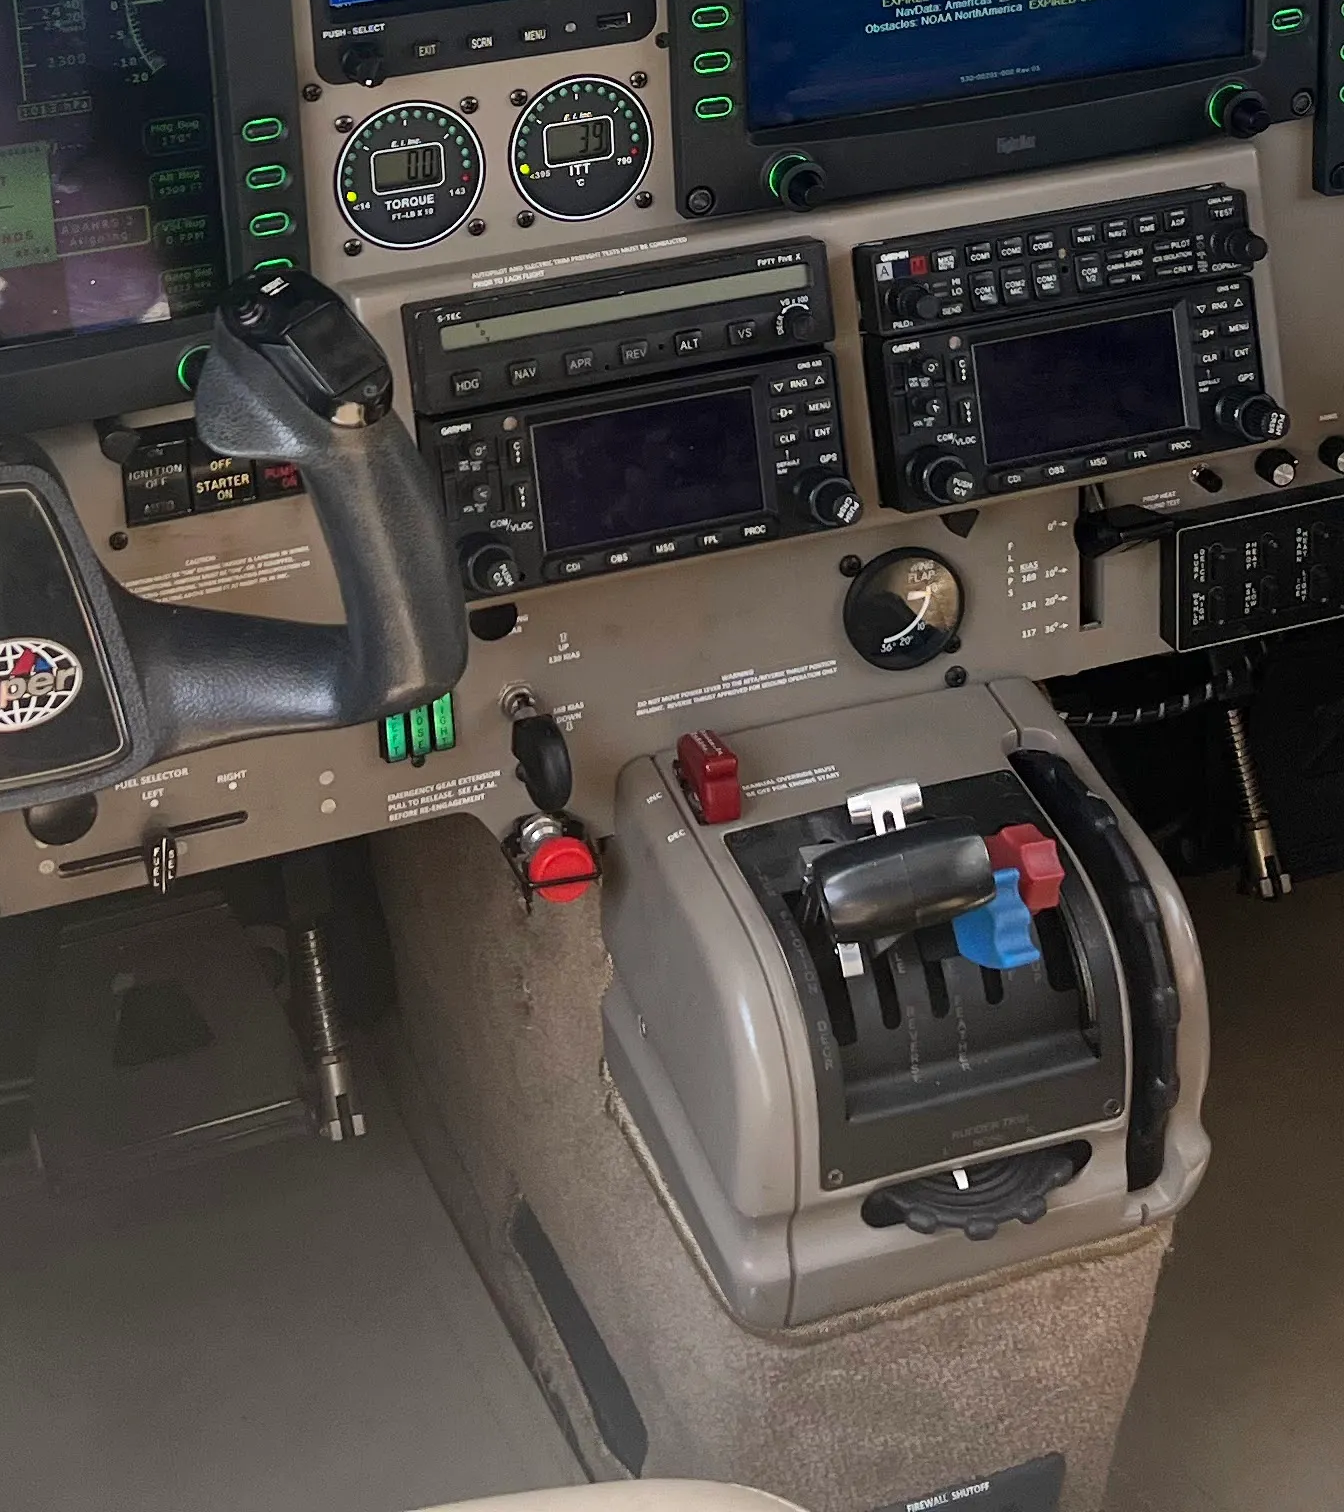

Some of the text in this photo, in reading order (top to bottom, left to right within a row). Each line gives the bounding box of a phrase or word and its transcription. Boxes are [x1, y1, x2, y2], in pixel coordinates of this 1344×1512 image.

[921, 13, 952, 26] NOAA
[955, 4, 1023, 21] NorthAmerica
[524, 29, 546, 42] MENU
[471, 37, 492, 49] SCRN
[418, 44, 436, 56] EXIT
[578, 123, 604, 154] 39
[569, 163, 591, 176] ITT
[385, 194, 435, 211] TORQUE
[437, 311, 462, 323] S-TEC
[737, 327, 752, 339] VS
[1229, 321, 1249, 333] MENU
[679, 338, 699, 352] ALT
[1233, 346, 1250, 357] ENT
[625, 348, 648, 361] REV
[1202, 353, 1218, 363] CLR
[570, 356, 592, 370] APR
[514, 367, 536, 380] NAV
[1238, 372, 1255, 383] GPS
[455, 378, 480, 392] HDG
[790, 377, 808, 389] RNG
[808, 399, 831, 412] MENU
[779, 432, 796, 443] CLR
[814, 426, 832, 438] ENT
[1171, 440, 1192, 452] PROC
[819, 451, 837, 464] GPS
[210, 458, 232, 472] OFF
[128, 463, 182, 481] IGNITION
[196, 474, 250, 494] STARTER
[217, 490, 233, 501] ON
[744, 523, 766, 536] PROC
[703, 534, 719, 545] FPL
[655, 542, 675, 554] MSG
[908, 571, 935, 583] FLAP
[556, 712, 582, 724] DOWN
[141, 767, 189, 786] SELECTOR
[216, 769, 247, 783] RIGHT
[142, 788, 164, 801] LEFT
[387, 785, 434, 802] EMERGENCY
[420, 794, 486, 814] RE-ENGAGEMENT
[667, 829, 686, 844] DEC
[906, 1482, 990, 1512] FIREWALL SHUTOFF
